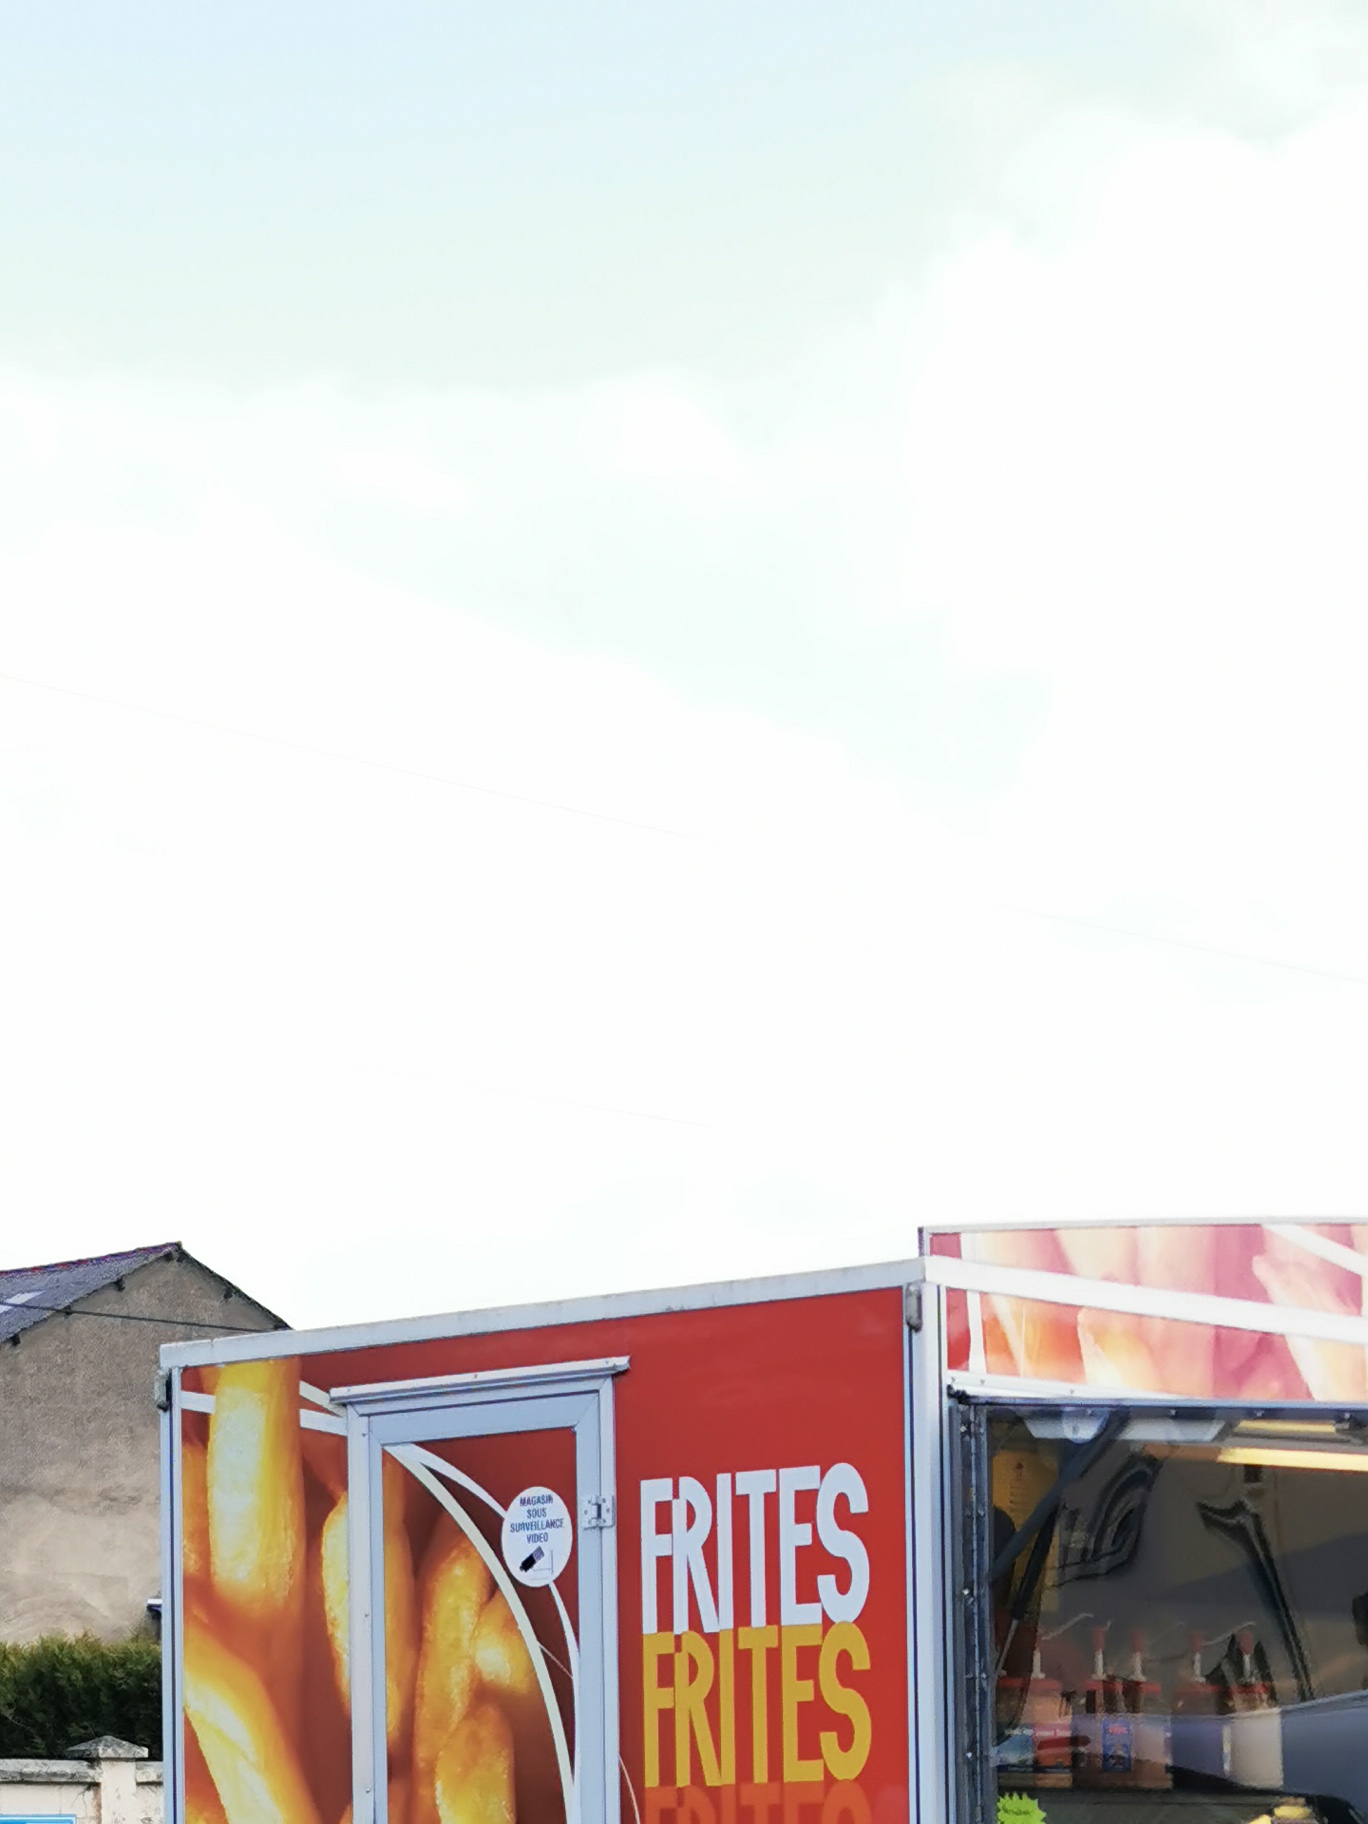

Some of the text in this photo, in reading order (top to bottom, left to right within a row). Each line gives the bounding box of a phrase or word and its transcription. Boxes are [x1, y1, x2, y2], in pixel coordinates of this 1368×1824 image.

[520, 1494, 553, 1506] MAGASIN
[526, 1508, 547, 1519] SOUS
[510, 1518, 564, 1532] SURVEILLANCE
[640, 1462, 870, 1634] FRITES
[642, 1620, 872, 1788] FRITES
